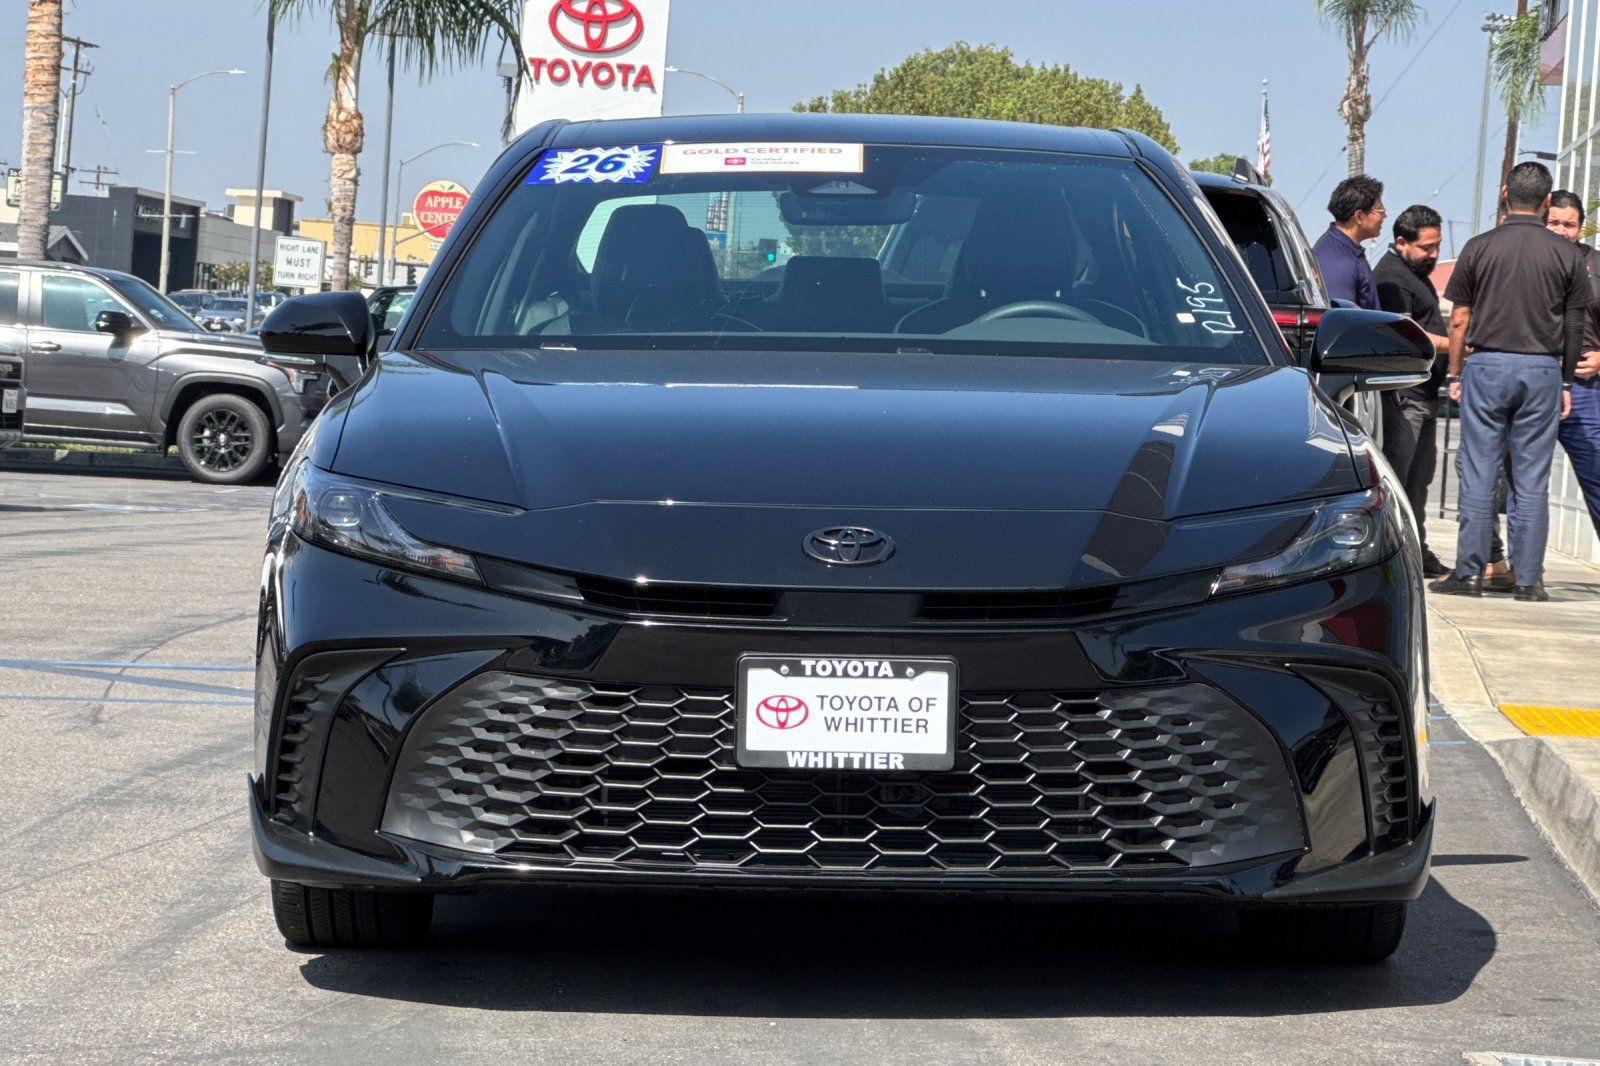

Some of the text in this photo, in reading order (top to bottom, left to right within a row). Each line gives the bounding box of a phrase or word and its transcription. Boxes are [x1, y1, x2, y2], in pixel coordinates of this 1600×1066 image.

[528, 58, 655, 89] TOYOTA
[560, 153, 631, 174] 26
[425, 195, 464, 209] APPLE
[420, 211, 458, 224] CENTE
[279, 244, 319, 254] RIGHT LANE
[286, 257, 311, 268] MUST
[277, 271, 317, 281] TURN RIGHT
[801, 660, 894, 678] TOYOTA
[816, 695, 938, 713] TOYOTA OF
[824, 717, 929, 734] WHITTIER
[786, 751, 905, 770] WHITTIER
